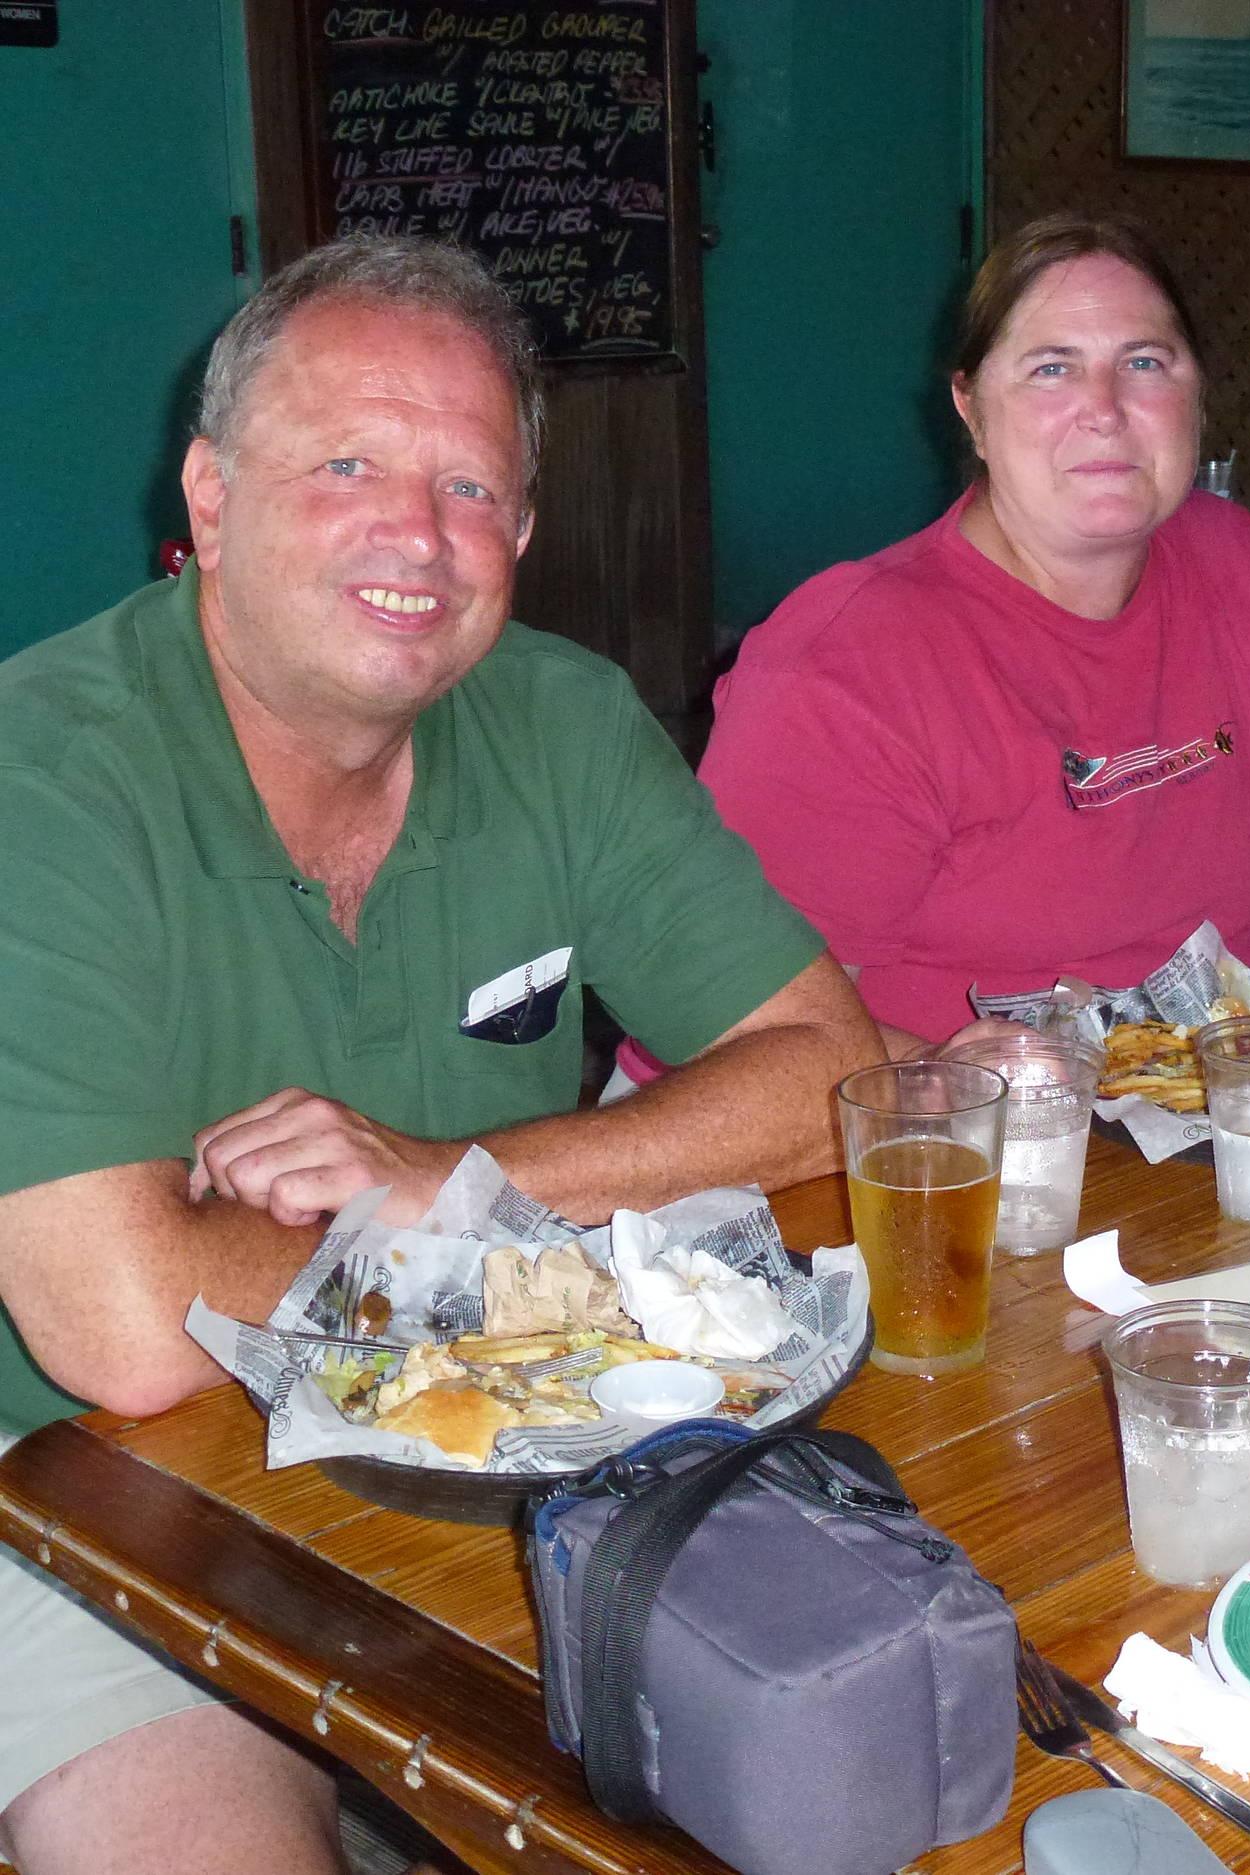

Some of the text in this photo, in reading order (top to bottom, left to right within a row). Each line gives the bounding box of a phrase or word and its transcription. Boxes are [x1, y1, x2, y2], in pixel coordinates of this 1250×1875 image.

[333, 118, 384, 144] KEY
[376, 149, 473, 175] STUFFED
[484, 146, 588, 171] LOBSTER
[496, 249, 588, 272] DINNER
